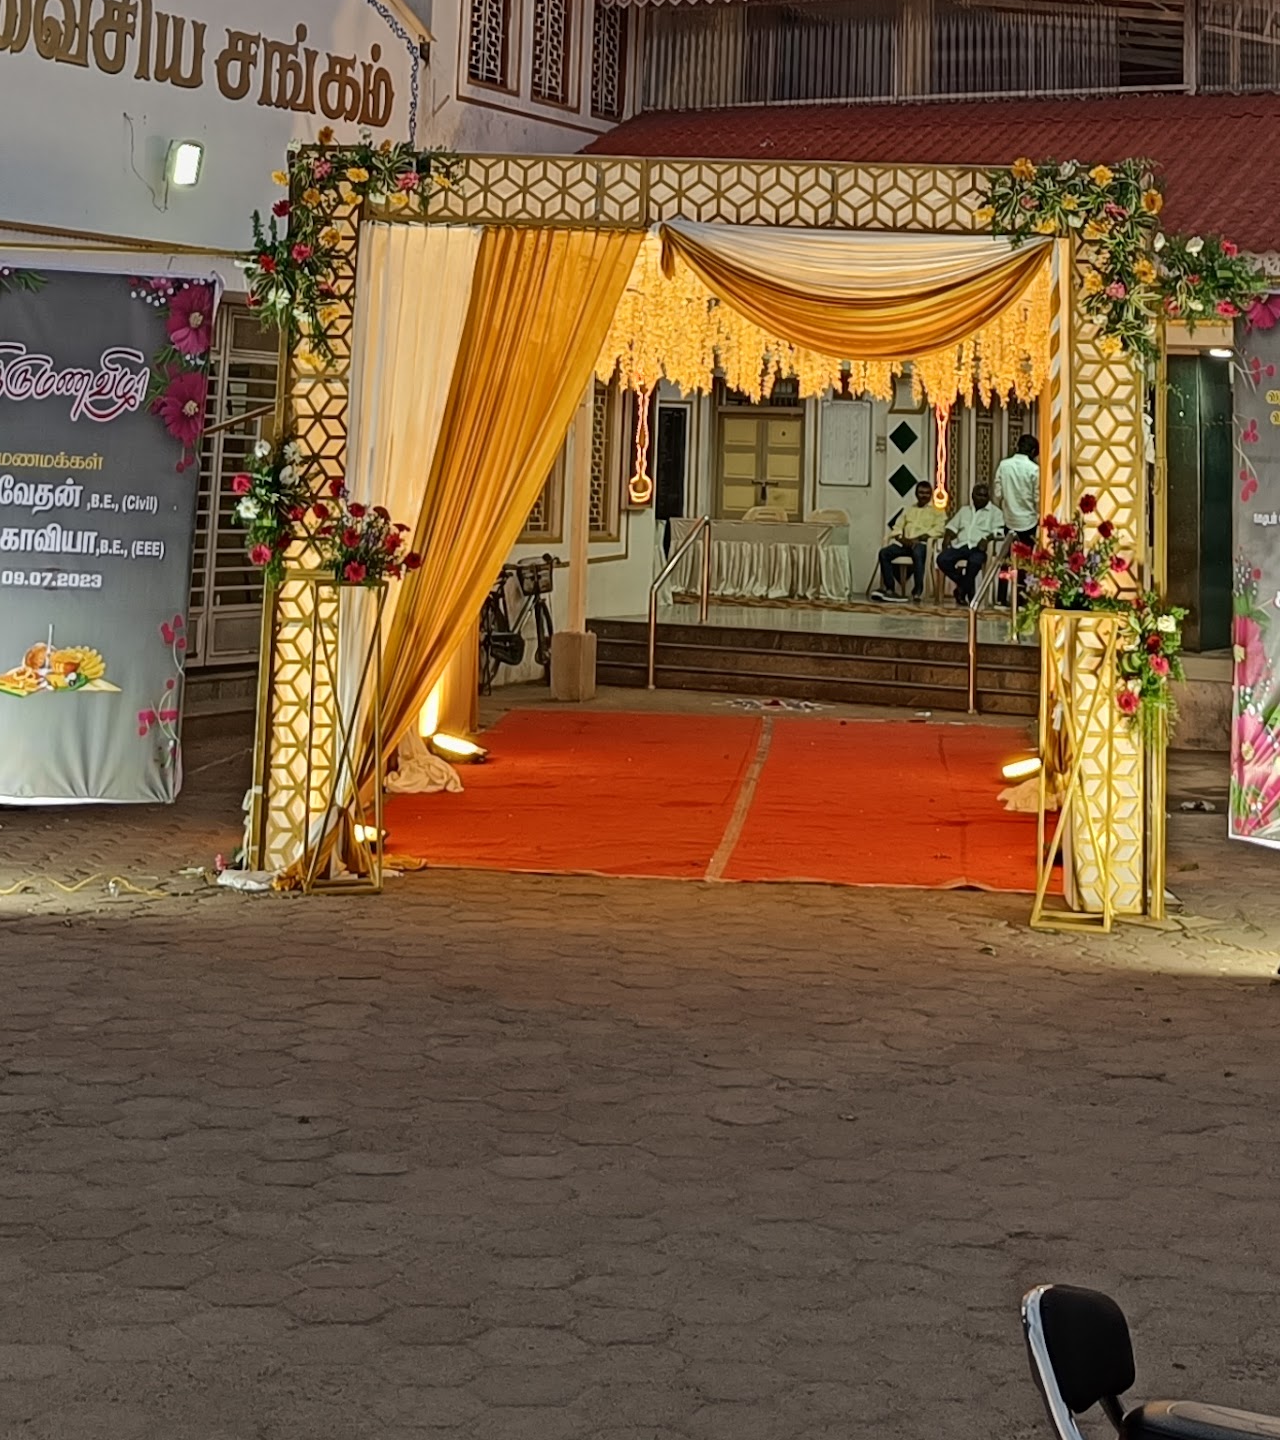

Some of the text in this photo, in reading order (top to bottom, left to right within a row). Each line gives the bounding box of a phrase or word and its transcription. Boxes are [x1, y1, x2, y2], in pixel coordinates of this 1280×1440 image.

[214, 24, 396, 128] சங்கம்
[121, 495, 158, 514] (Civil)
[131, 540, 165, 560] (EEE)
[1, 570, 103, 588] 09.07.2023
